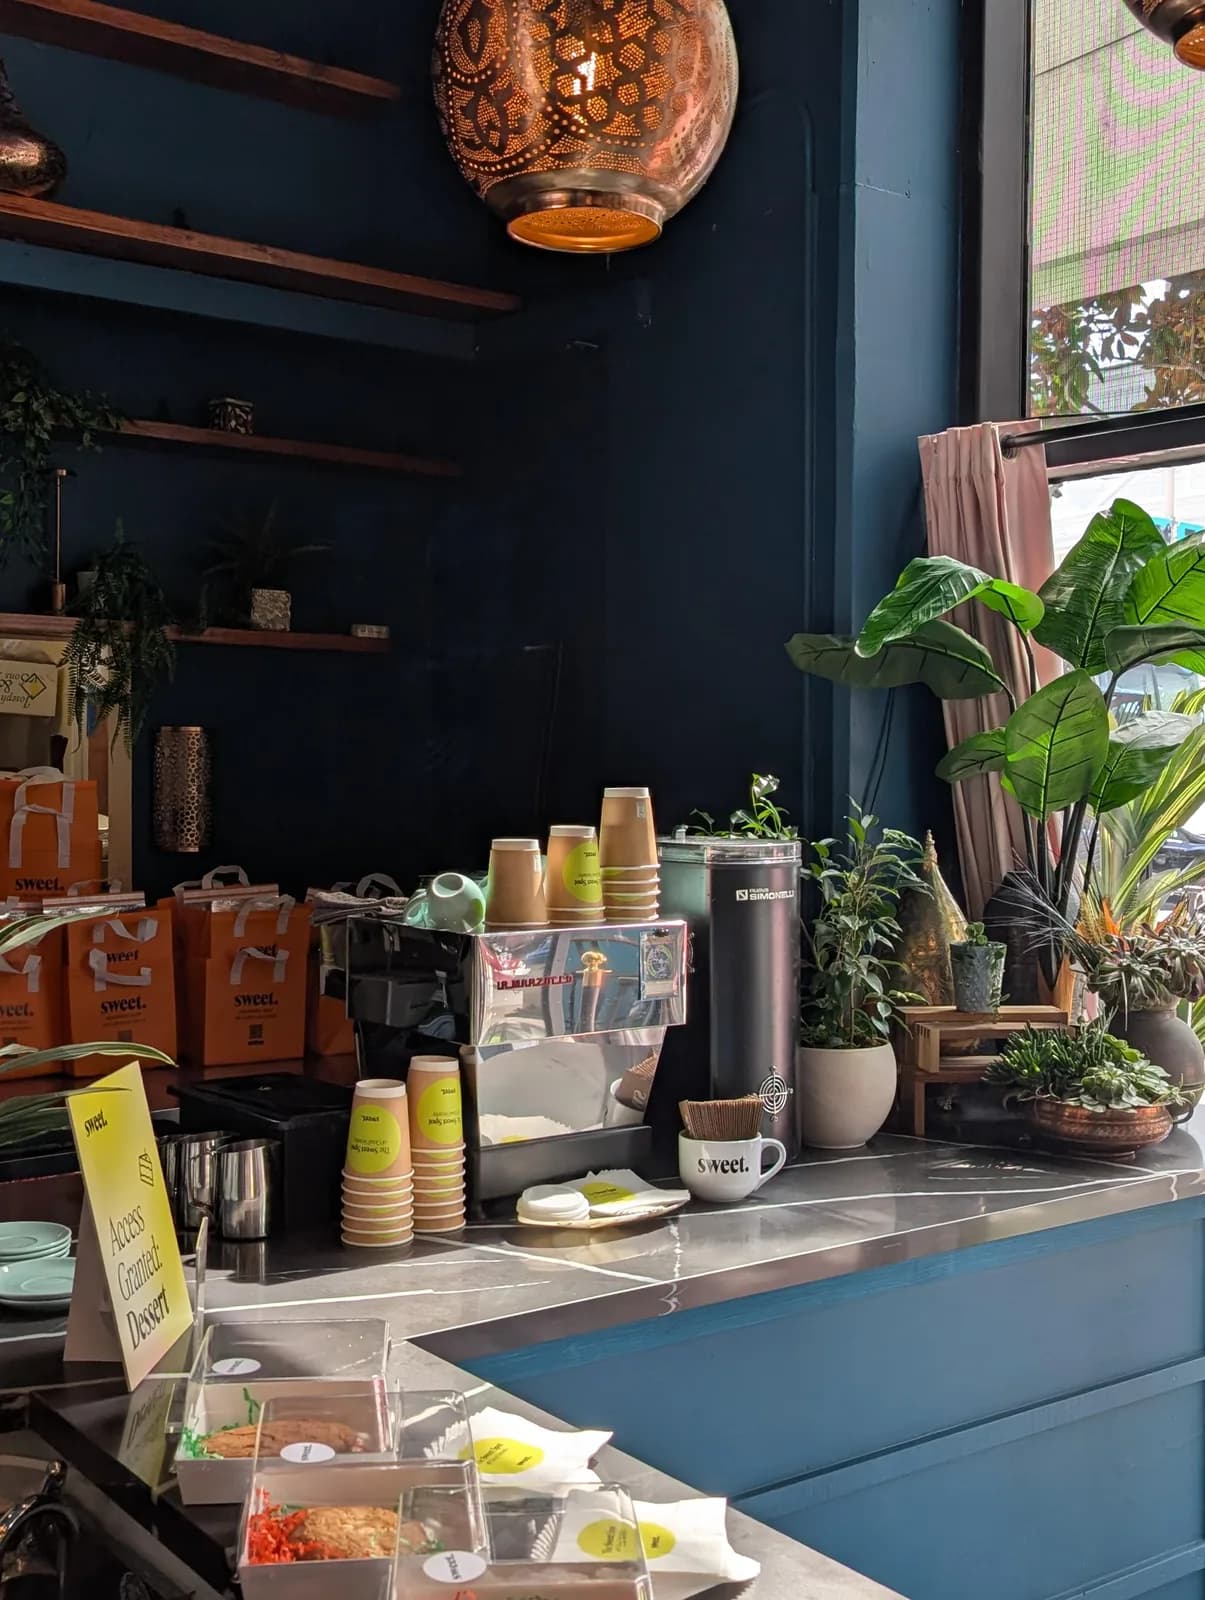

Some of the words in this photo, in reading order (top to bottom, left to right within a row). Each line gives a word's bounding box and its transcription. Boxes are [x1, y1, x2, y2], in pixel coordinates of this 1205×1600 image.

[15, 876, 65, 891] sweet.
[100, 996, 147, 1015] sweet.
[233, 992, 279, 1008] sweet.
[84, 1108, 108, 1137] sweet.
[697, 1155, 750, 1174] sweet.
[109, 1205, 145, 1257] Access
[117, 1235, 163, 1301] Granted:
[126, 1283, 170, 1352] Dessert
